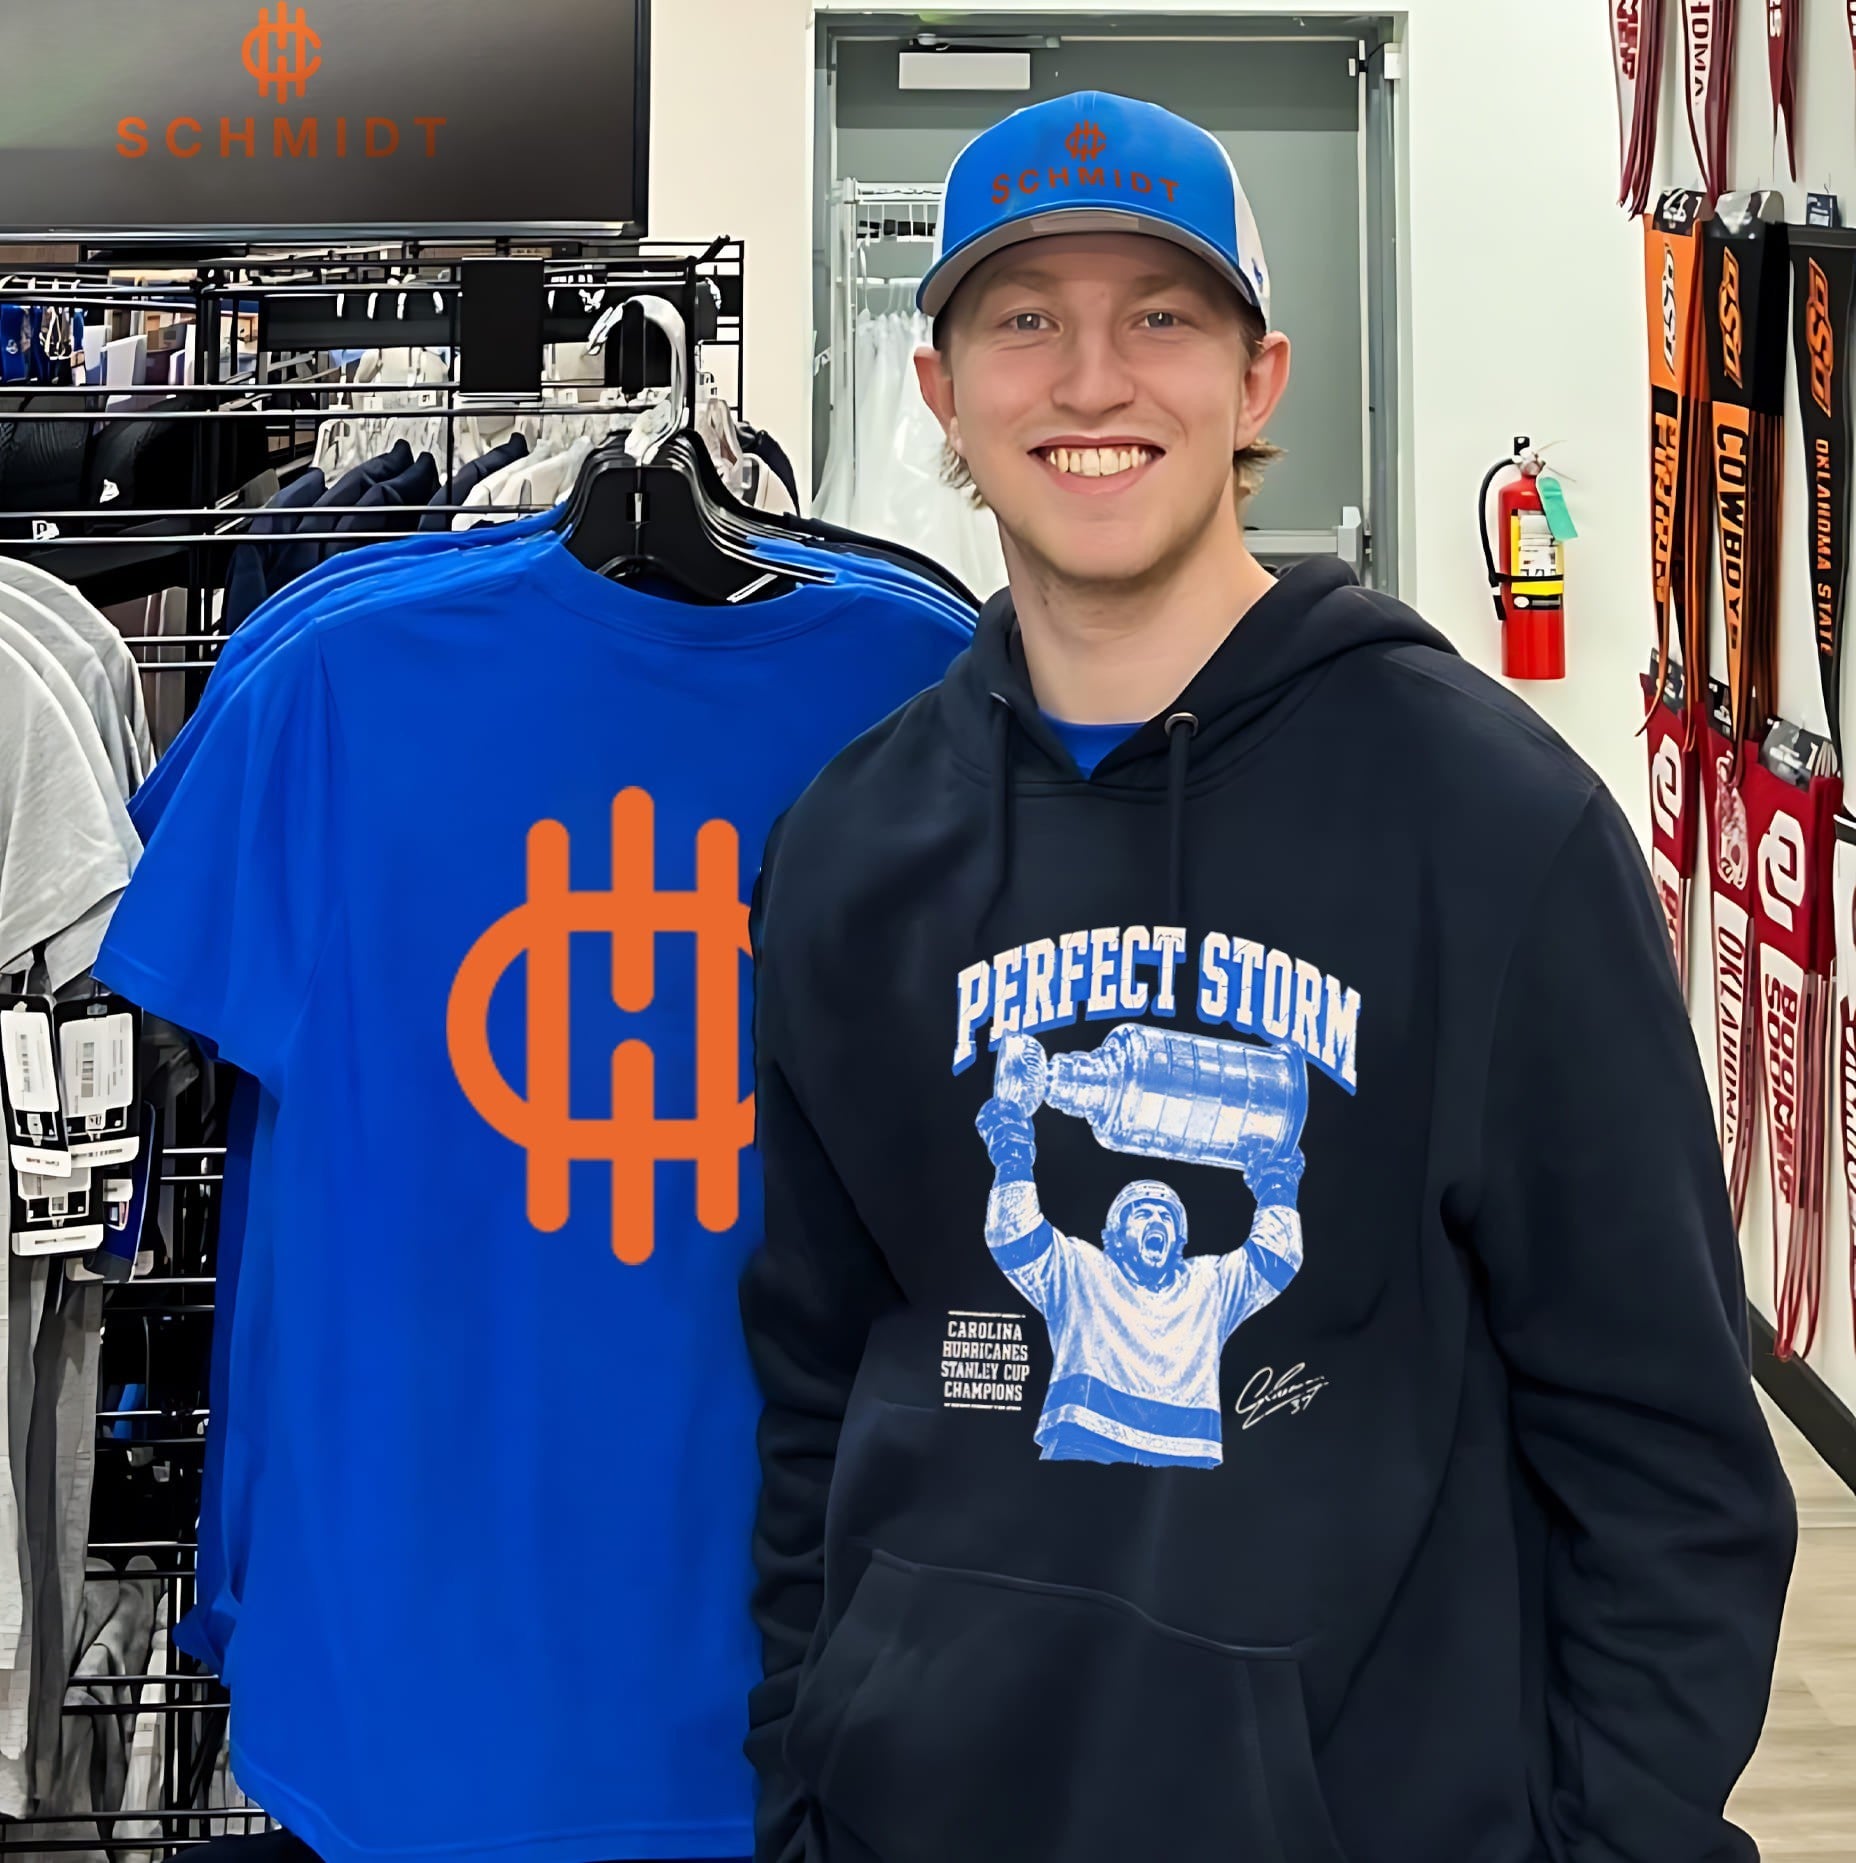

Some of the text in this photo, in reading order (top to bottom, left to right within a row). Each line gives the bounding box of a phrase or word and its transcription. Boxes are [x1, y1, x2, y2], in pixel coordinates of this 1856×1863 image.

[116, 116, 447, 159] SCHMIDT
[991, 167, 1179, 205] SCHMIDT
[1815, 438, 1834, 657] OKLAHOMA STATE
[952, 925, 1362, 1095] PERFECT STORM
[947, 1320, 1023, 1341] CAROLINA
[942, 1340, 1028, 1361] HURRICANES
[941, 1360, 1030, 1382] STANLEY CUP
[944, 1380, 1023, 1402] CHAMPIONS
